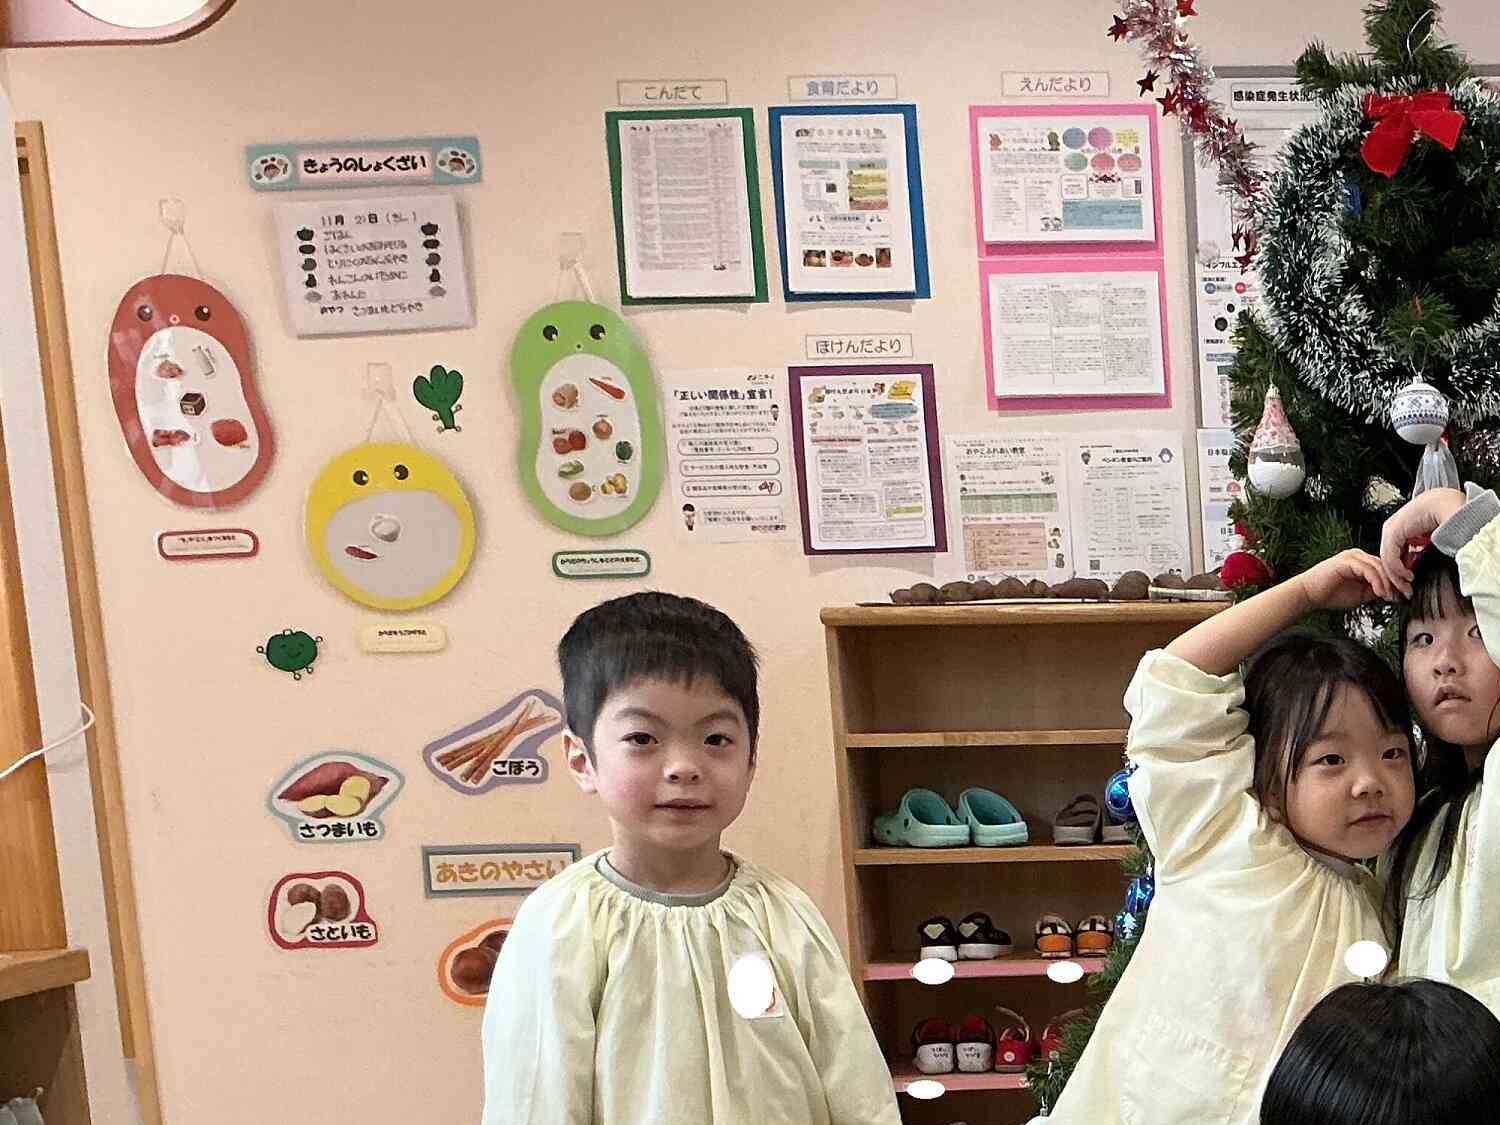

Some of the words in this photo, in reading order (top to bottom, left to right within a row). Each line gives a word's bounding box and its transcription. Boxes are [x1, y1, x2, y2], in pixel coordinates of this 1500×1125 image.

[807, 79, 879, 96] 食育だより
[1020, 77, 1092, 92] えんだより
[644, 85, 702, 100] こんだて
[303, 155, 426, 174] きょうのしょくざい
[1205, 261, 1242, 270] インフルエ
[815, 339, 901, 354] ほけんだより
[300, 822, 378, 838] さつまいも
[435, 860, 566, 883] あきのやさい
[310, 926, 372, 940] さといも
